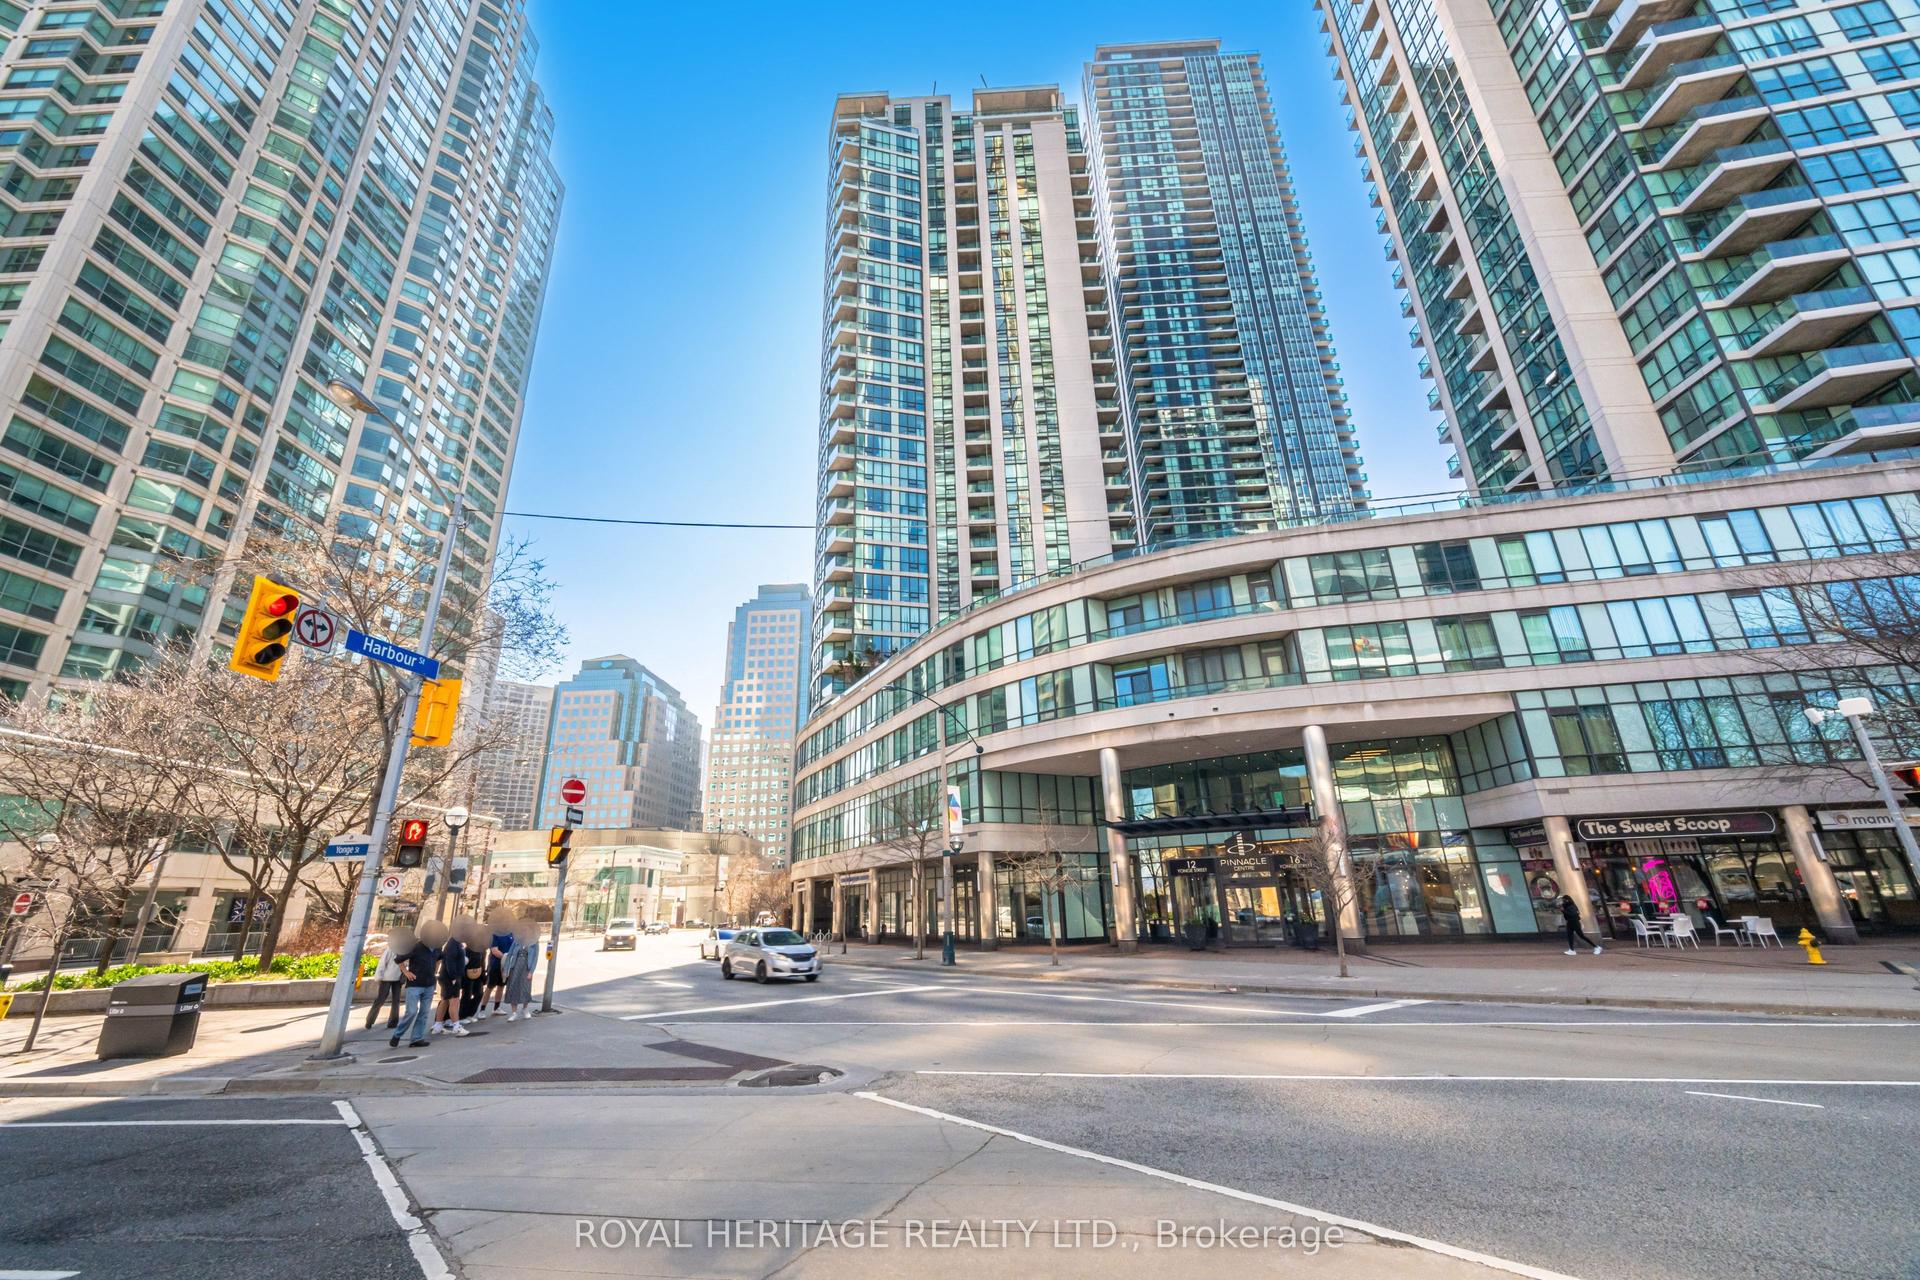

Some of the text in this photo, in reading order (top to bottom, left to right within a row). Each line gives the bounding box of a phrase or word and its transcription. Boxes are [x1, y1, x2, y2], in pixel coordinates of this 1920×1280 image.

[363, 637, 426, 667] Harbour St
[1851, 815, 1894, 825] mam
[1584, 821, 1617, 835] The
[1620, 819, 1671, 834] Sweet
[1673, 817, 1731, 832] Scoop
[336, 846, 353, 855] Yonge
[1186, 860, 1196, 868] 12
[1220, 857, 1267, 866] PINNACLE
[1289, 856, 1300, 864] 16
[180, 1004, 193, 1012] Litter
